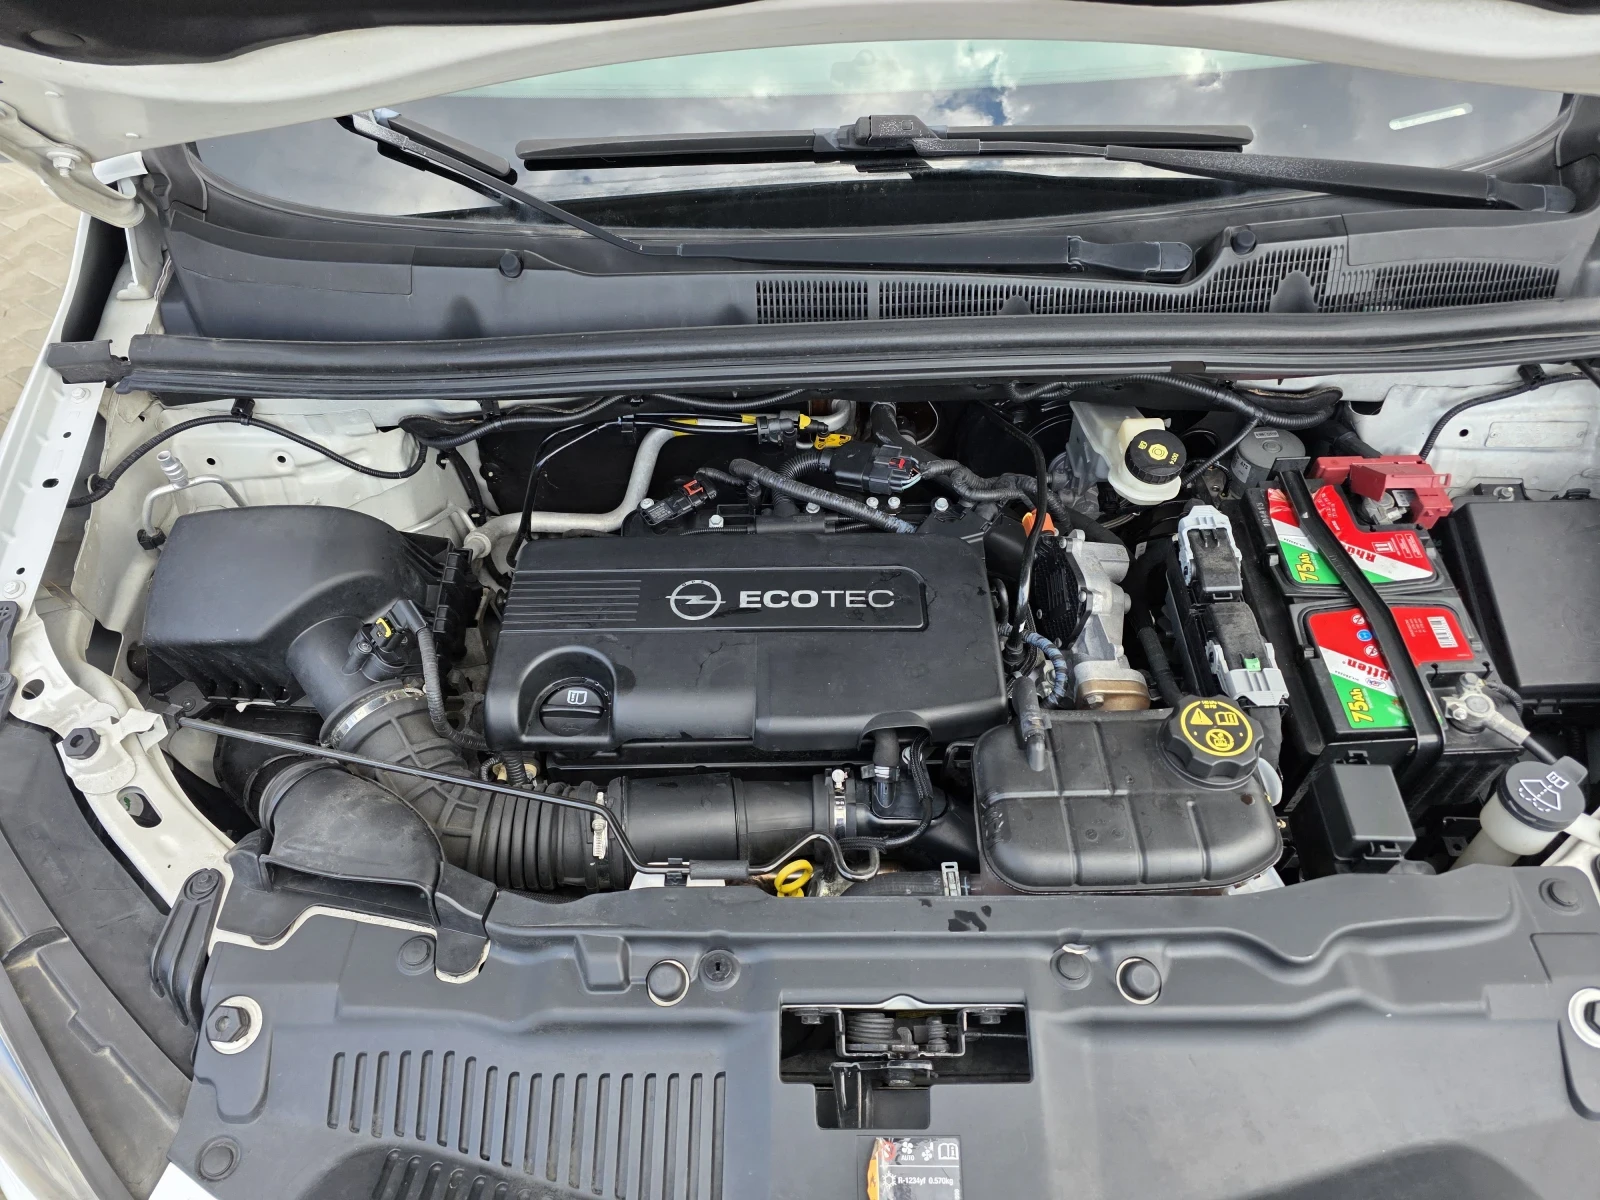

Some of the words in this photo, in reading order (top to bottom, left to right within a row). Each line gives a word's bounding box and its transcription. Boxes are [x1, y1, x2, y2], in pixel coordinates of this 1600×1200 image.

[1345, 544, 1377, 563] Rhü
[1296, 552, 1319, 582] 75Ah
[739, 590, 895, 608] ECOTEC
[1347, 657, 1391, 681] ütten
[1347, 687, 1374, 723] 75Ah
[897, 1177, 926, 1186] R-1234yf
[928, 1177, 954, 1186] 0.570kg
